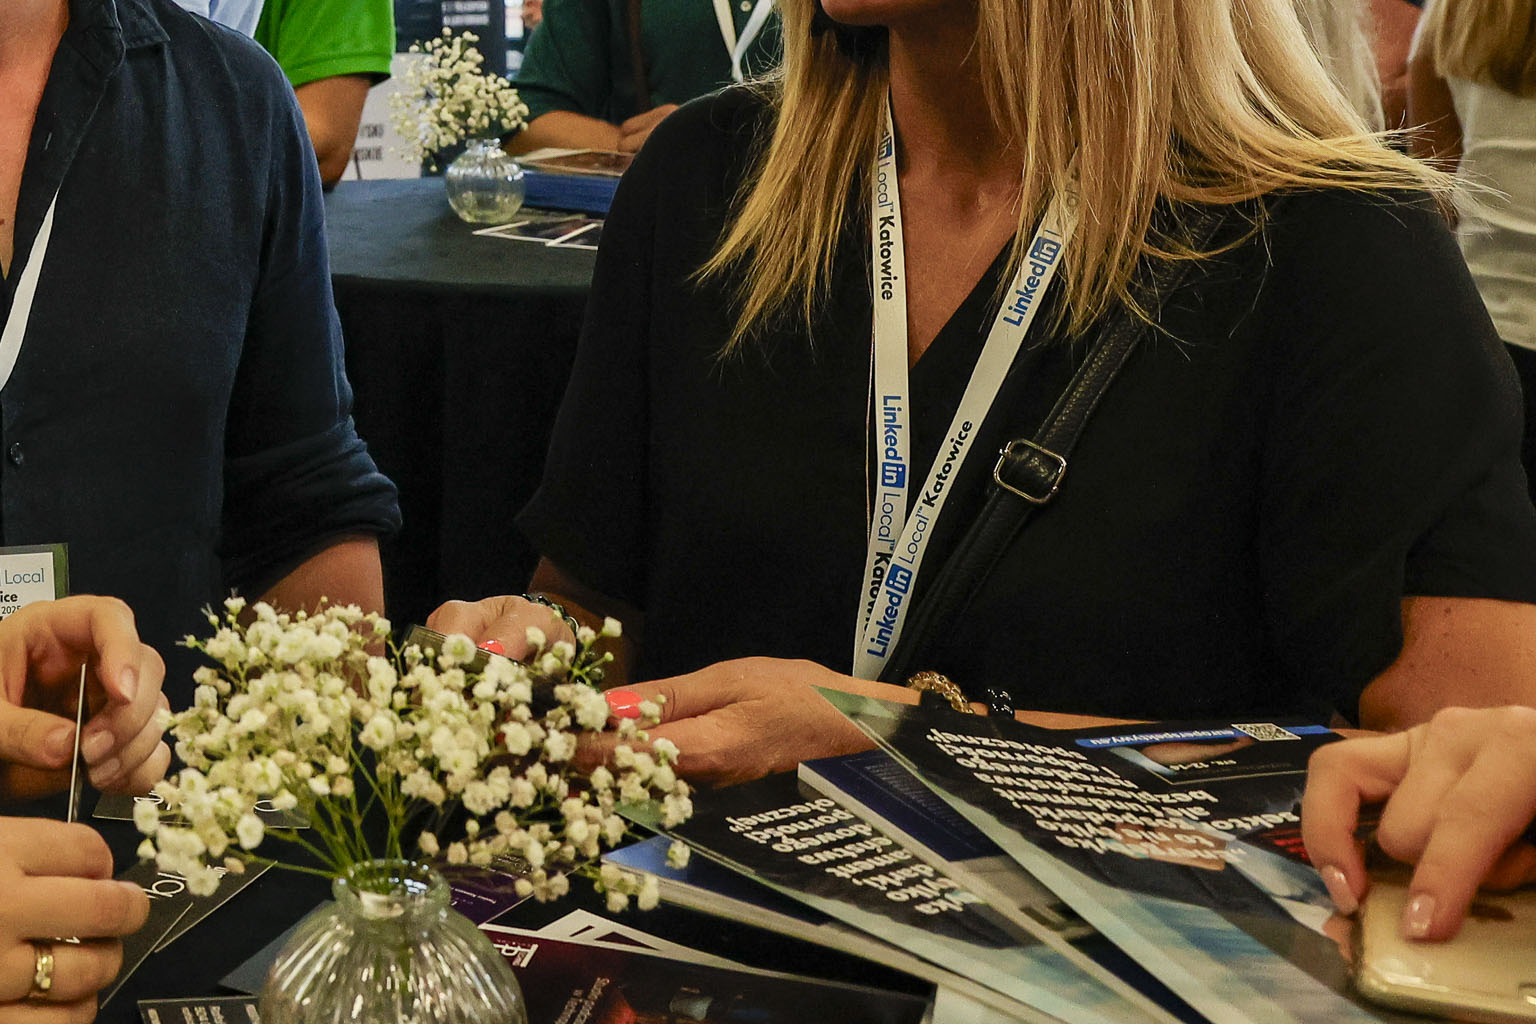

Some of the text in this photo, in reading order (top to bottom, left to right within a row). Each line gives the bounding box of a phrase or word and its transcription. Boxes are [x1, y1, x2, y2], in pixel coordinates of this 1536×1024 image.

[879, 215, 898, 301] Katowice
[922, 420, 973, 508] Katowice
[5, 568, 45, 584] Local
[1090, 729, 1235, 744] europerspektywy.eu
[936, 743, 1099, 772] odporności
[956, 756, 1140, 789] narodowego
[973, 772, 1219, 804] bezpieczeństwa
[992, 787, 1210, 820] ale fundament
[1012, 801, 1300, 831] sektor gospodarki,
[1036, 819, 1215, 848] to nie tylko
